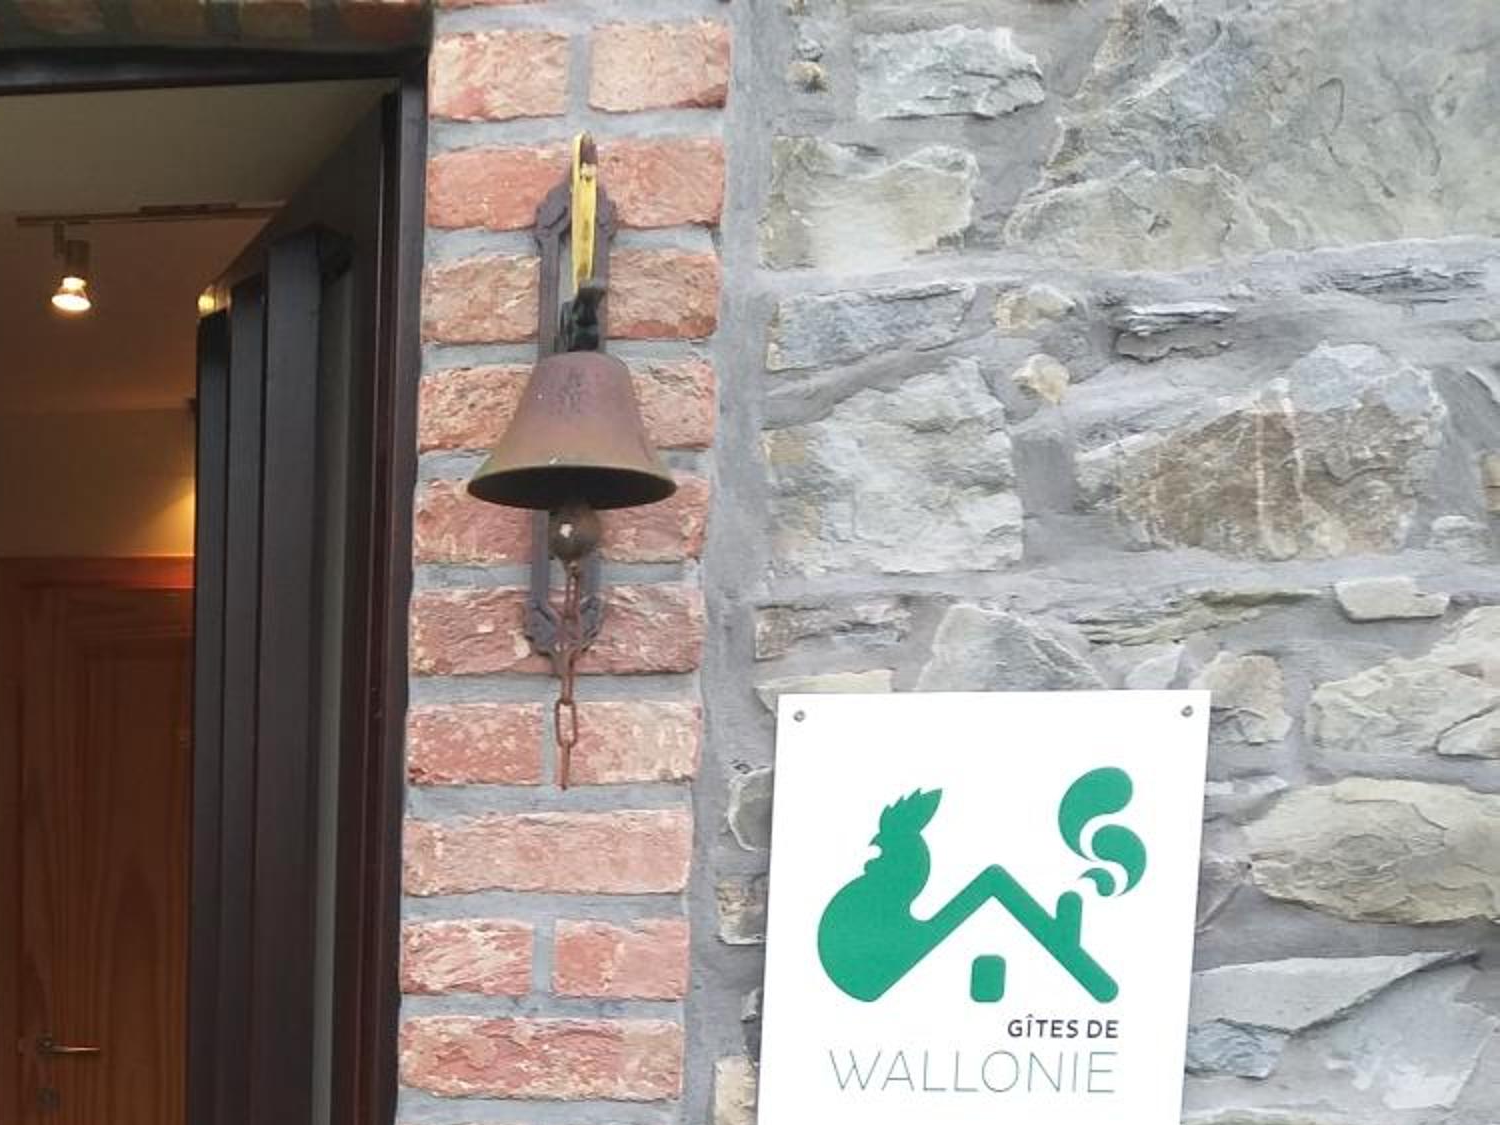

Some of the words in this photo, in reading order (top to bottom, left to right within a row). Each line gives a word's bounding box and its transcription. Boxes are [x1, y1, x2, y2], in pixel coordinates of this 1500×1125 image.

[1006, 1013, 1079, 1039] GÎTES
[1086, 1019, 1119, 1039] DE
[828, 1049, 1119, 1093] WALLONIE
